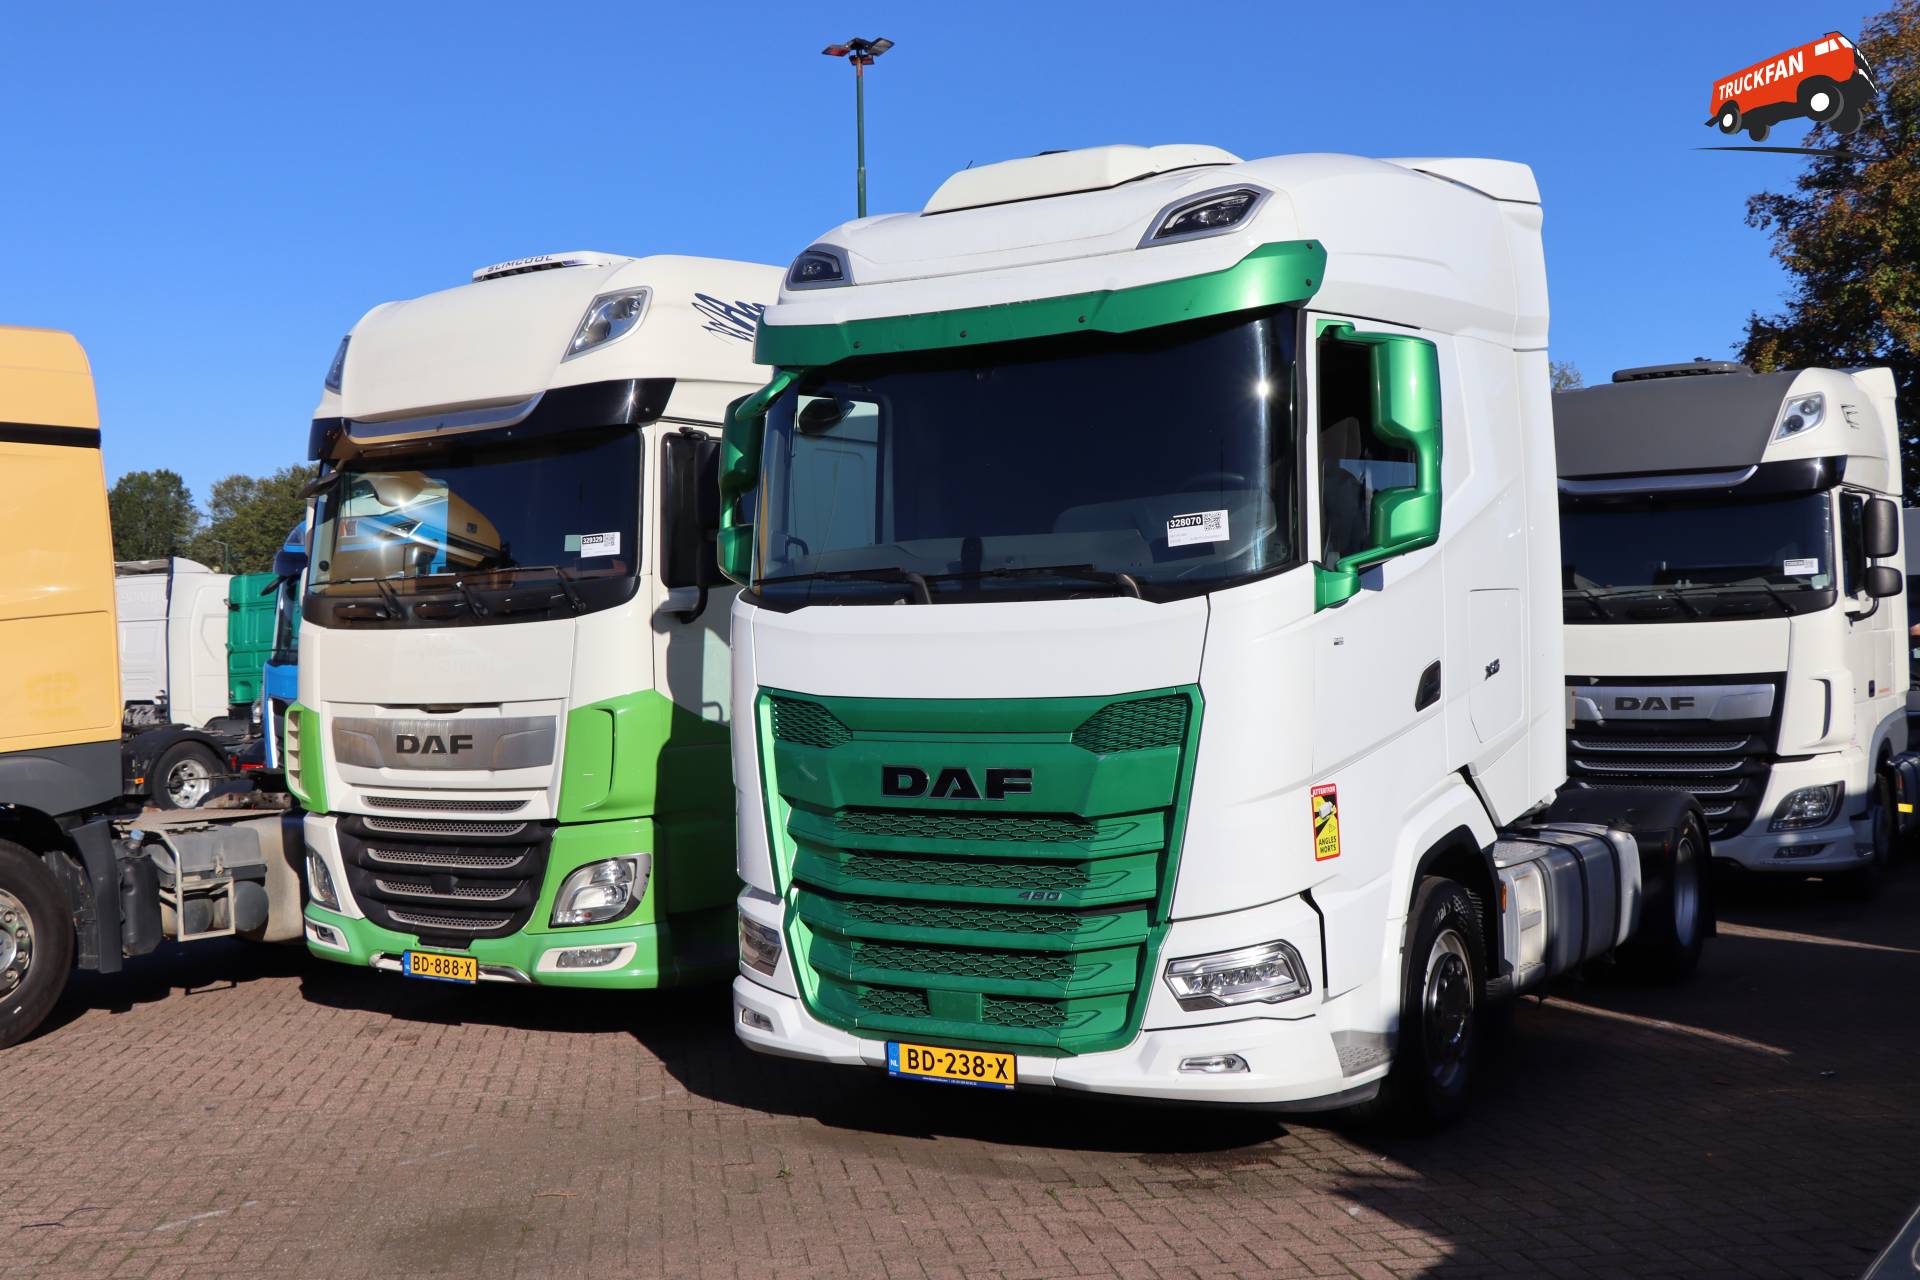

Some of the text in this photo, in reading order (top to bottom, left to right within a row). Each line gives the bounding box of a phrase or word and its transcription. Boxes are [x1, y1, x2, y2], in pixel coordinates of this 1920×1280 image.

[487, 255, 553, 272] SLIMCOOL
[1169, 516, 1202, 528] 328070
[1614, 696, 1696, 711] DAF
[395, 734, 473, 754] DAF
[881, 764, 1035, 801] DAF
[1312, 786, 1336, 797] ATTENTION
[1318, 836, 1337, 846] ANGLES
[1319, 844, 1337, 854] MORTS
[413, 955, 472, 977] BD-888-X
[890, 1059, 899, 1067] NL
[907, 1048, 1009, 1080] BD-238-X
